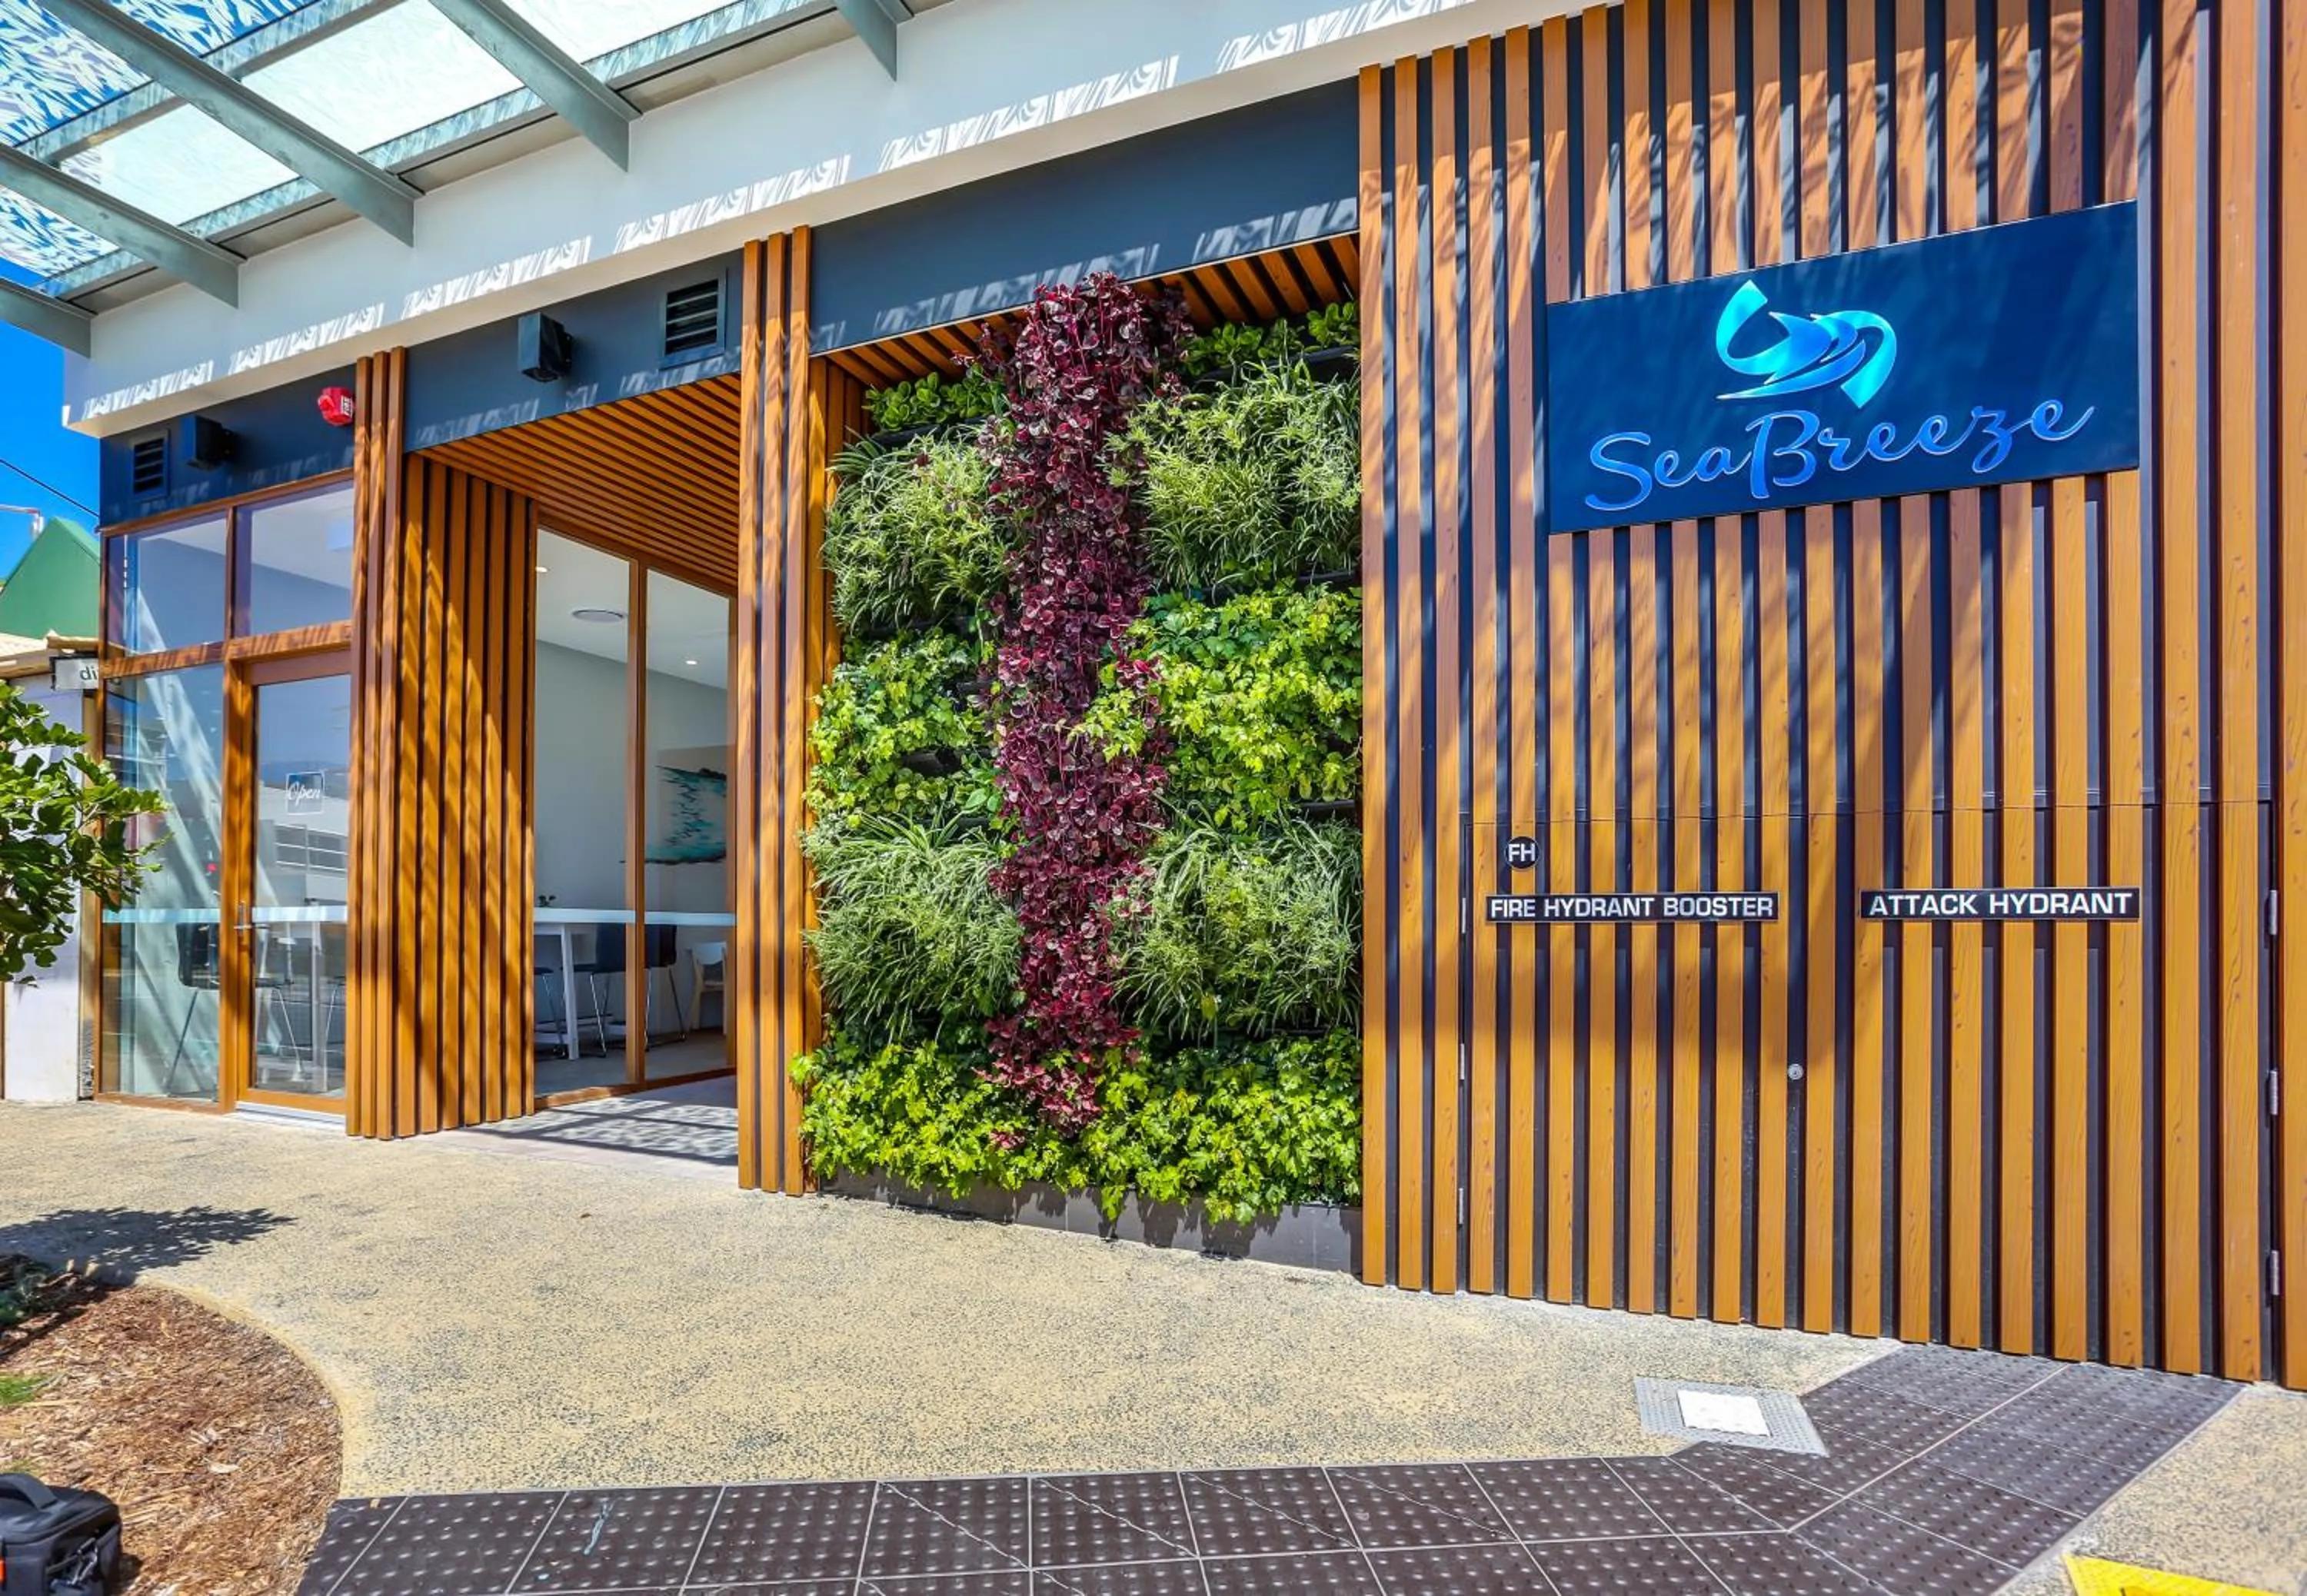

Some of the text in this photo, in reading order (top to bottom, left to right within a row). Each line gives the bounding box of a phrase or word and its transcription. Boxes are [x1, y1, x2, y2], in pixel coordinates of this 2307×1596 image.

[1585, 399, 2095, 511] SeaBreeze
[79, 667, 99, 680] di
[288, 780, 321, 806] Open
[1508, 843, 1536, 862] FH
[1491, 896, 1773, 918] FIRE HYDRANT BOOSTER
[1869, 893, 2132, 915] ATTACK HYDRANT
